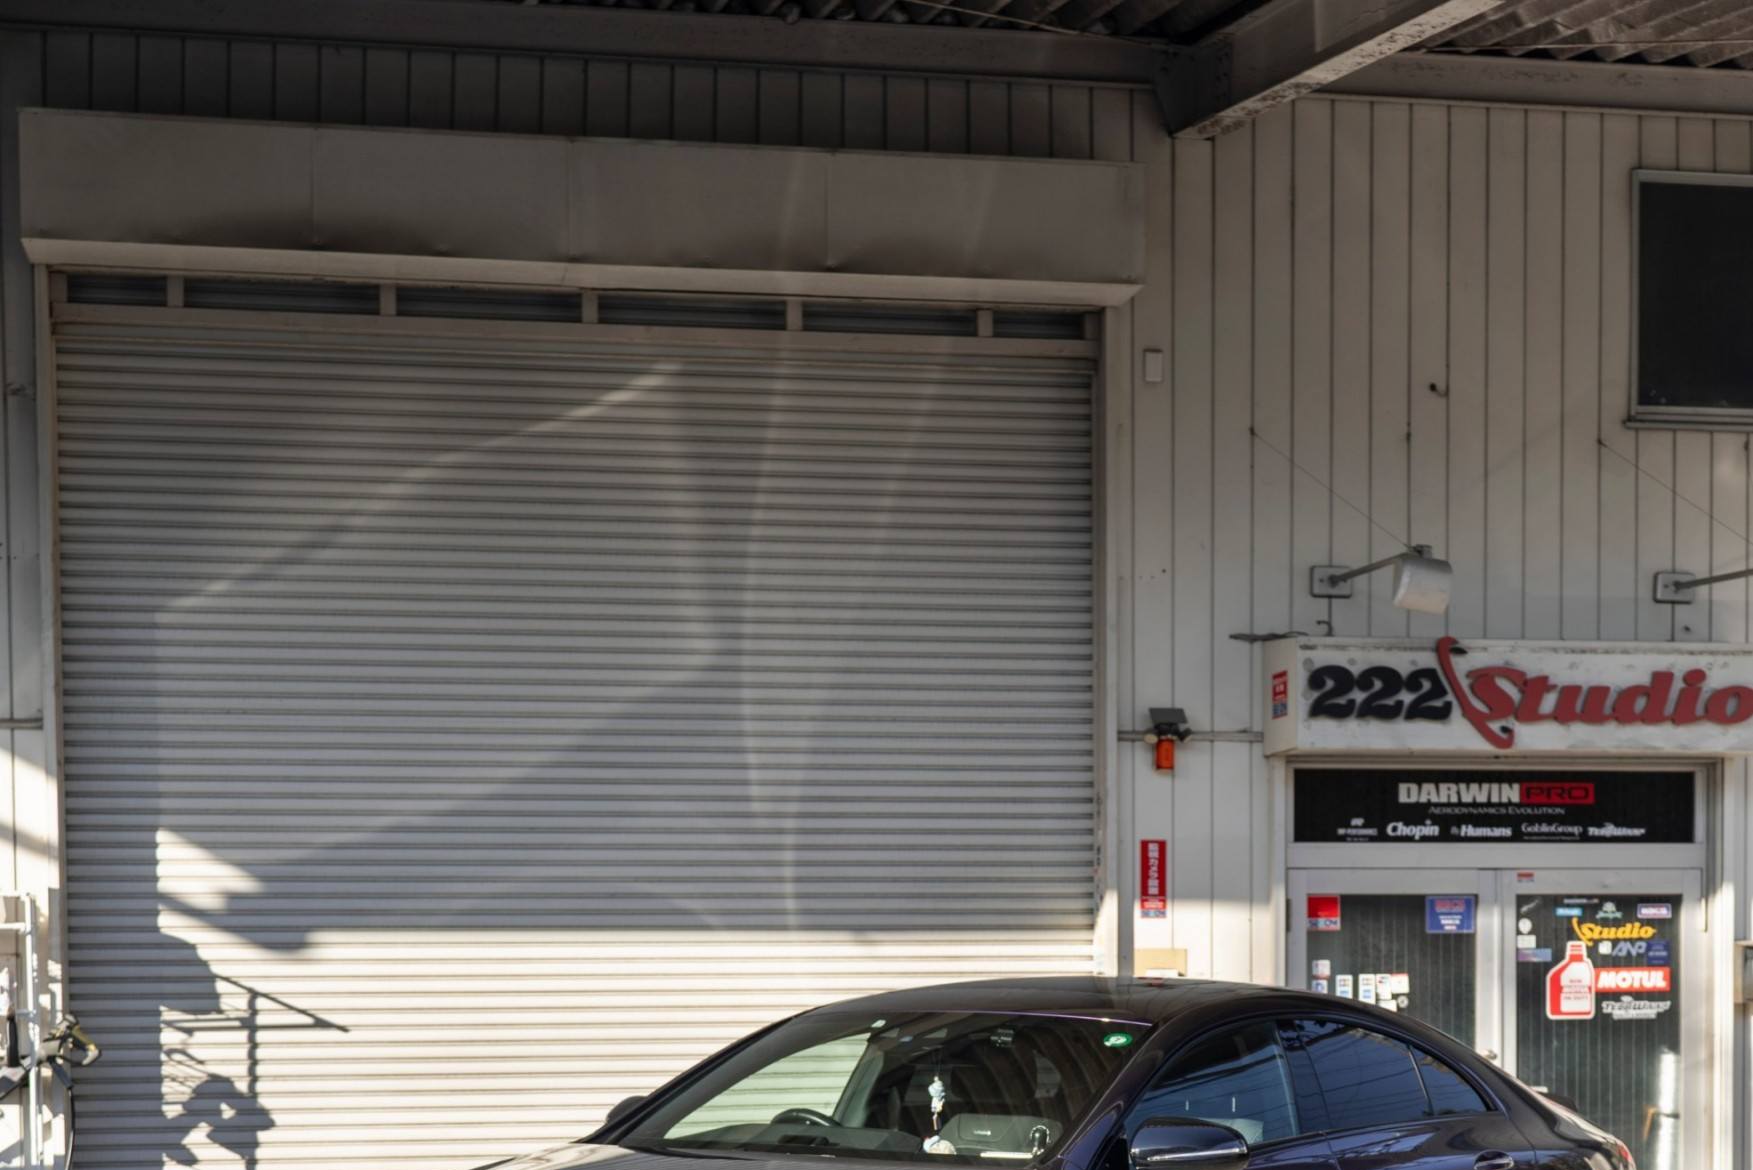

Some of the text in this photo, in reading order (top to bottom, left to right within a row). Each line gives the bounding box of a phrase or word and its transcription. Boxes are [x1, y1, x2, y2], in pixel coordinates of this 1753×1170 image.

[1307, 665, 1452, 721] 222
[1445, 645, 1753, 742] Studio
[1398, 783, 1591, 803] DARWIN PRO
[1386, 819, 1440, 840] Chopin
[1460, 824, 1513, 837] Humans
[1575, 918, 1657, 942] Studio
[1598, 970, 1667, 989] MOTUL
